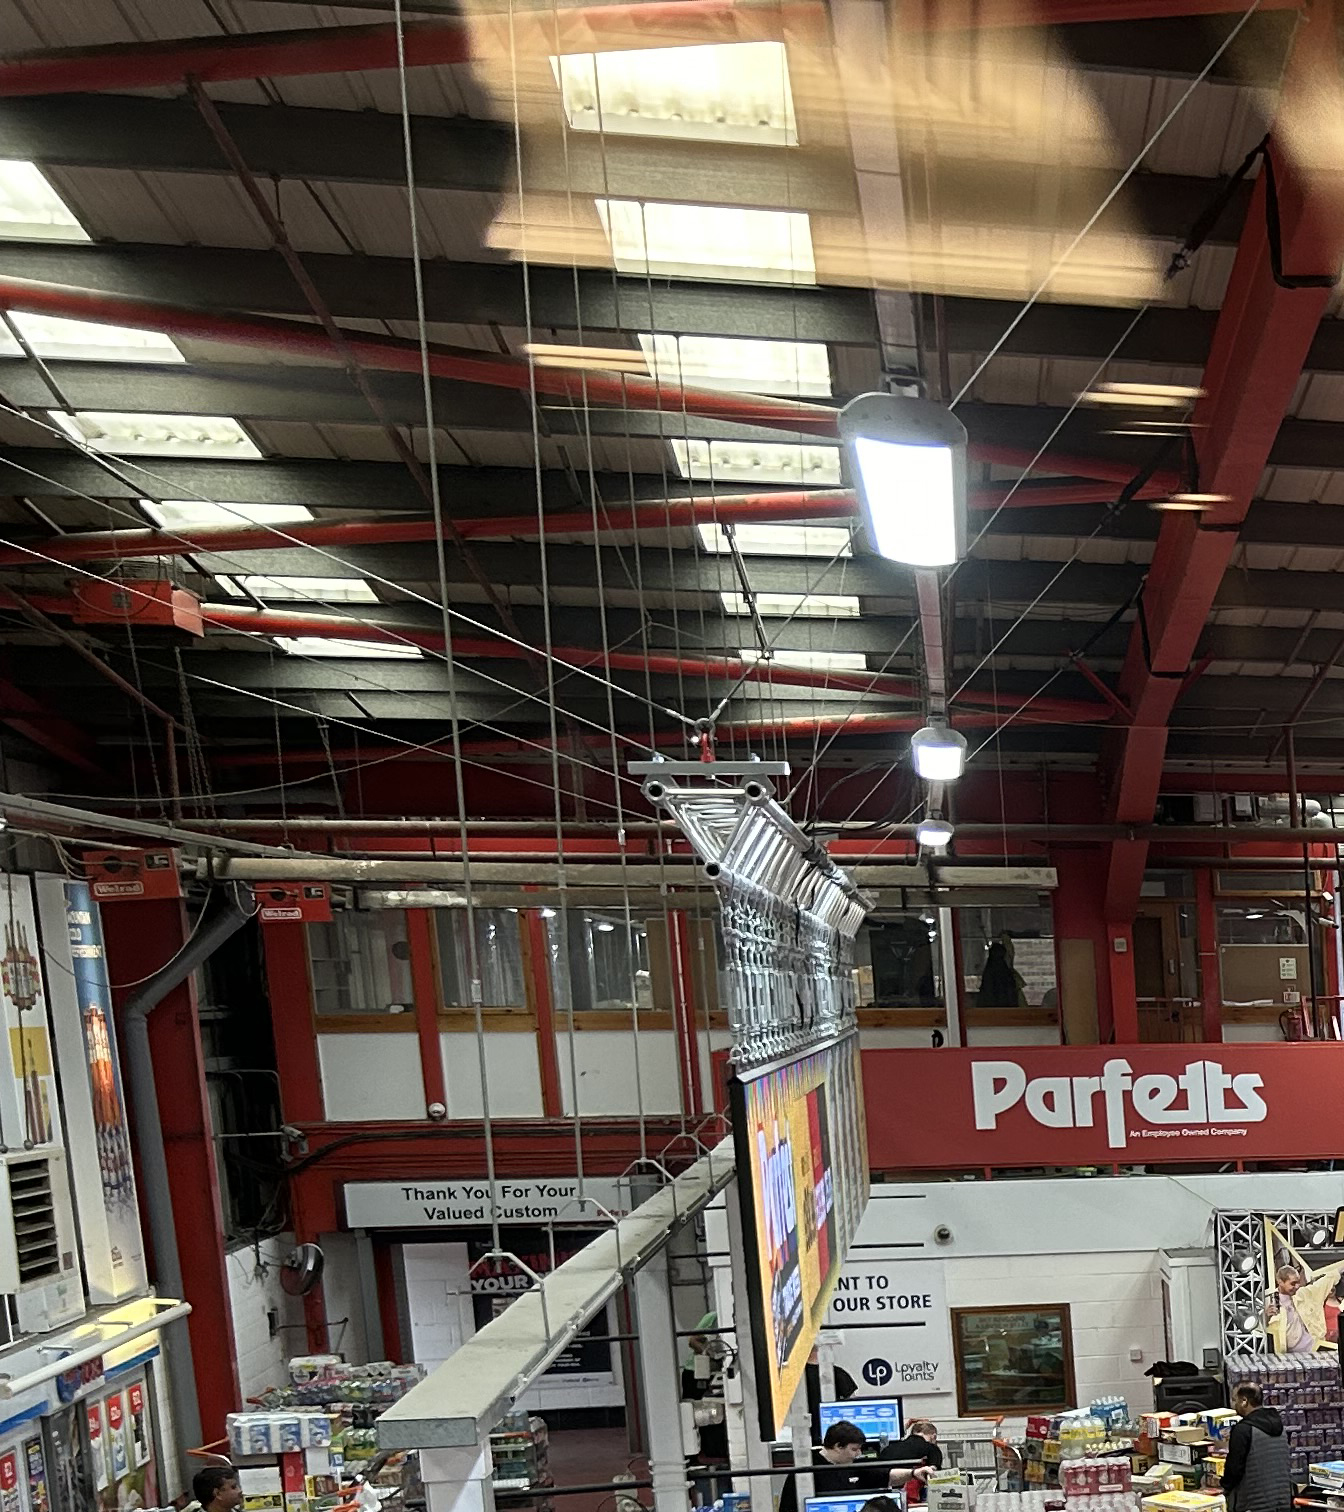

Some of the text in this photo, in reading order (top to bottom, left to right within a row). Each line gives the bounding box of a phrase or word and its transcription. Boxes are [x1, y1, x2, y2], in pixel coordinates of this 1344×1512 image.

[971, 1059, 1268, 1148] Parfetts
[1142, 1128, 1180, 1137] Employee
[1182, 1128, 1209, 1136] Owned
[1211, 1127, 1247, 1137] Company
[402, 1186, 457, 1201] Thank
[501, 1185, 531, 1199] For
[536, 1184, 576, 1198] Your
[876, 1294, 932, 1311] STORE
